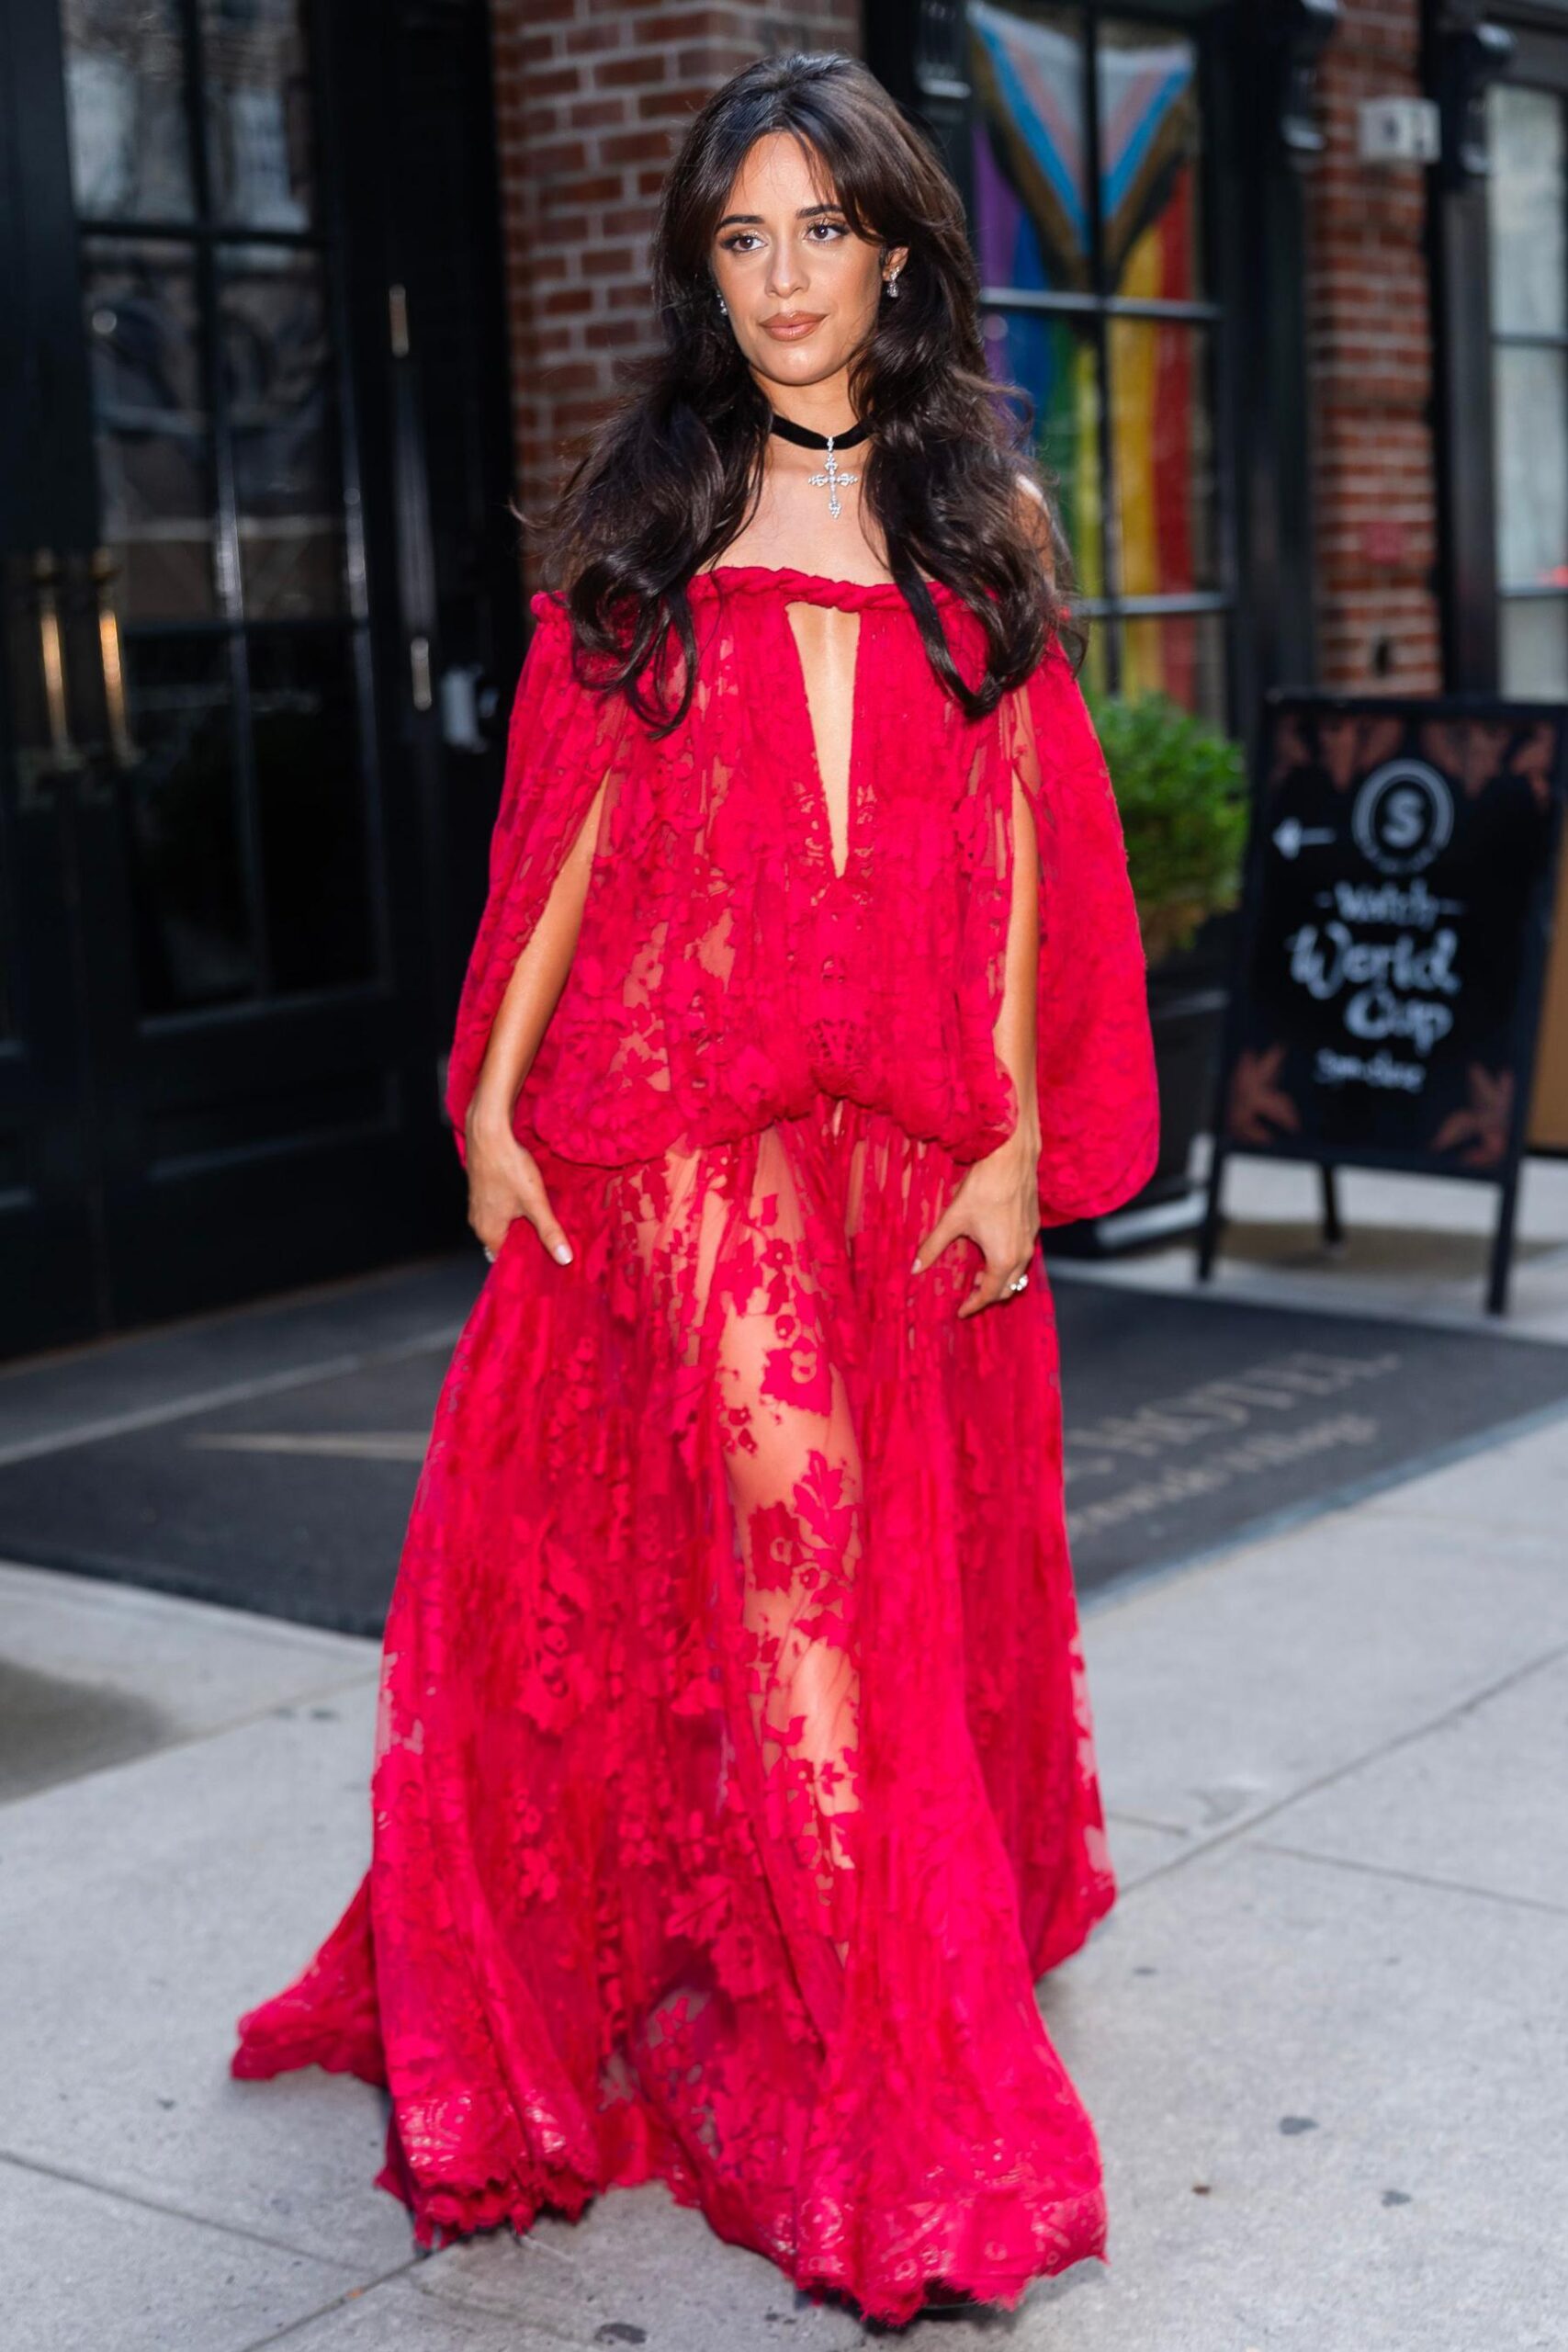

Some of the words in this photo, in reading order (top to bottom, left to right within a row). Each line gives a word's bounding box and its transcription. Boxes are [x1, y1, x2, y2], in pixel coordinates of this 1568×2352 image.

[1381, 787, 1426, 849] S
[1286, 921, 1462, 1000] World
[1344, 985, 1455, 1057] Cup
